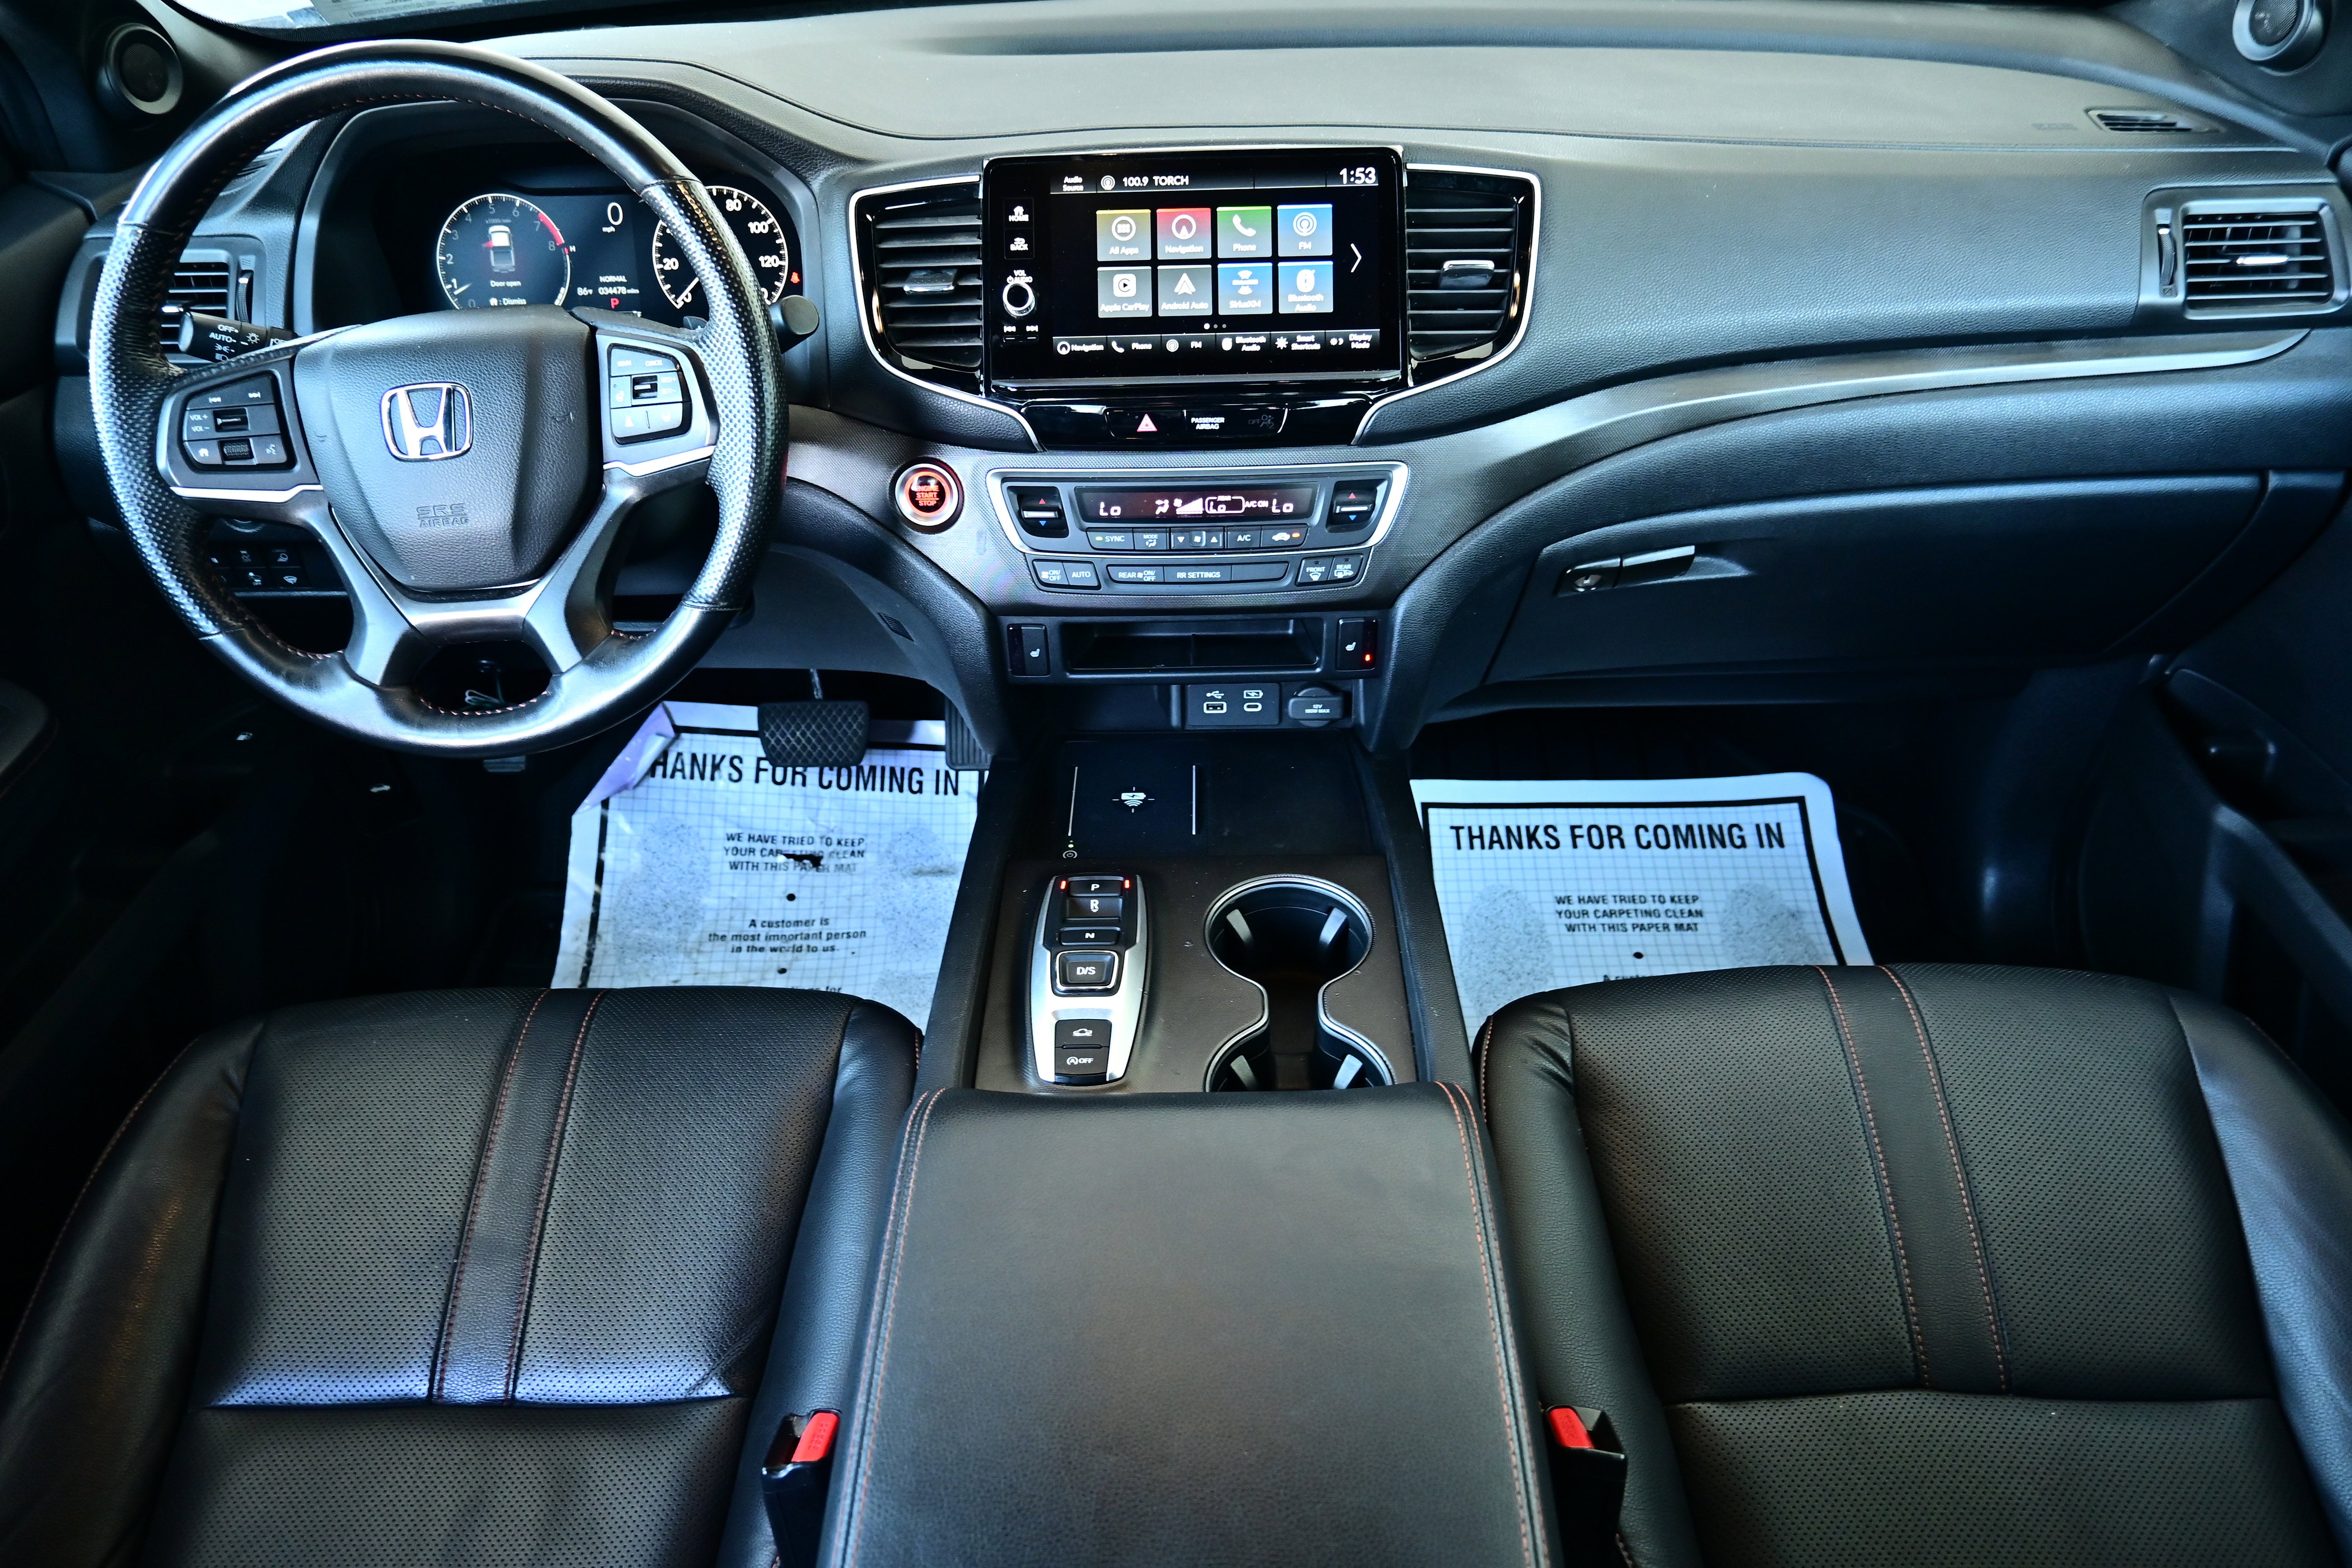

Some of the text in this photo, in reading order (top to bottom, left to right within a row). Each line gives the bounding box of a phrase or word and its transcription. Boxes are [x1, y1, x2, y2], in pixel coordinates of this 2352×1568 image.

[1339, 167, 1376, 184] 1:53
[1123, 175, 1189, 187] 100.9 TORCH
[489, 204, 495, 214] 5
[726, 199, 742, 211] 80
[512, 207, 519, 217] 6
[607, 202, 623, 226] 0
[465, 213, 472, 223] 4
[534, 221, 541, 231] 7
[748, 221, 769, 234] 100
[452, 230, 459, 240] 3
[549, 241, 555, 251] 8
[1109, 247, 1139, 255] All Apps
[1165, 245, 1203, 254] Navigation
[1233, 243, 1256, 252] Phone
[1298, 242, 1311, 250] FM
[446, 254, 453, 264] 2
[663, 258, 679, 270] 20
[759, 256, 779, 268] 120
[451, 278, 457, 289] 1
[598, 286, 626, 295] 034478
[1288, 294, 1323, 302] Bluetooth
[610, 298, 620, 309] P
[1100, 303, 1149, 312] Apple CarPlay
[1161, 302, 1209, 310] Android Auto
[1229, 300, 1261, 309] SiriusXM
[1295, 303, 1317, 312] Audio
[218, 324, 235, 333] OFF
[209, 332, 232, 343] AUTO
[1236, 336, 1266, 344] Bluetooth
[1349, 334, 1372, 342] Display
[1071, 343, 1104, 352] Navigation
[416, 503, 466, 517] SRS
[419, 517, 470, 528] AIRBAG
[1105, 534, 1125, 542] SYNC
[650, 750, 743, 782] HANKS
[819, 765, 924, 795] COMING
[934, 769, 959, 795] IN
[726, 833, 865, 847] WE HAVE TRIED TO KEEP
[1450, 822, 1785, 850] THANKS FOR COMING IN
[724, 847, 755, 857] YOUR
[729, 861, 759, 871] WITH
[764, 862, 788, 871] THIS
[1090, 899, 1099, 909] R
[1555, 895, 1699, 905] WE HAVE TRIED TO KEEP
[1556, 909, 1703, 919] YOUR CARPETING CLEAN
[749, 917, 829, 928] A customer is
[1565, 923, 1699, 932] WITH THIS PAPER MAT
[708, 933, 727, 942] the
[731, 933, 760, 942] most
[826, 930, 866, 941] person
[731, 945, 742, 953] in
[746, 945, 765, 953] the
[807, 945, 818, 953] to
[1076, 966, 1096, 975] D/S
